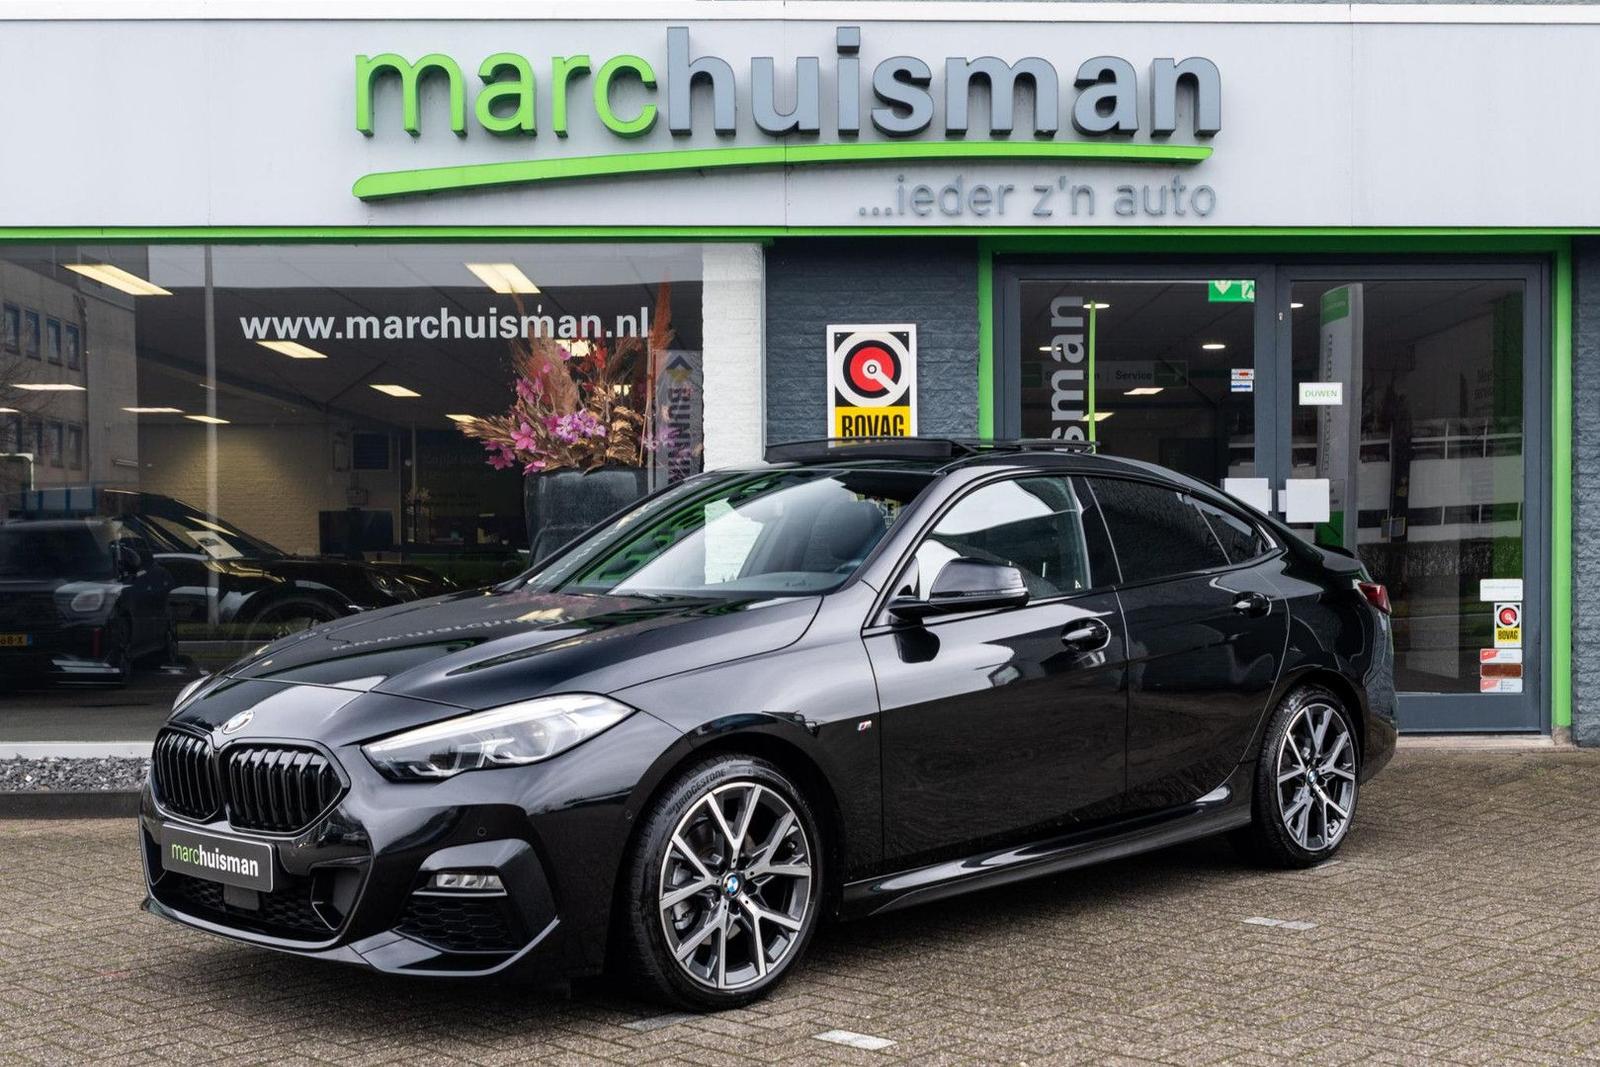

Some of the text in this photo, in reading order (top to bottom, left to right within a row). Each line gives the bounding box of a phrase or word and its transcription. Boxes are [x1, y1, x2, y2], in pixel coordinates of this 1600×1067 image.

[355, 26, 1222, 139] marchuisman
[1033, 178, 1095, 217] z'n
[1113, 179, 1217, 217] auto
[239, 306, 650, 340] www.marchuisman.nl
[1115, 370, 1153, 381] Service
[1304, 389, 1338, 398] DUWEN
[841, 414, 905, 438] BOVAG
[1497, 630, 1518, 640] BOVAG
[170, 842, 259, 878] marchuisman
